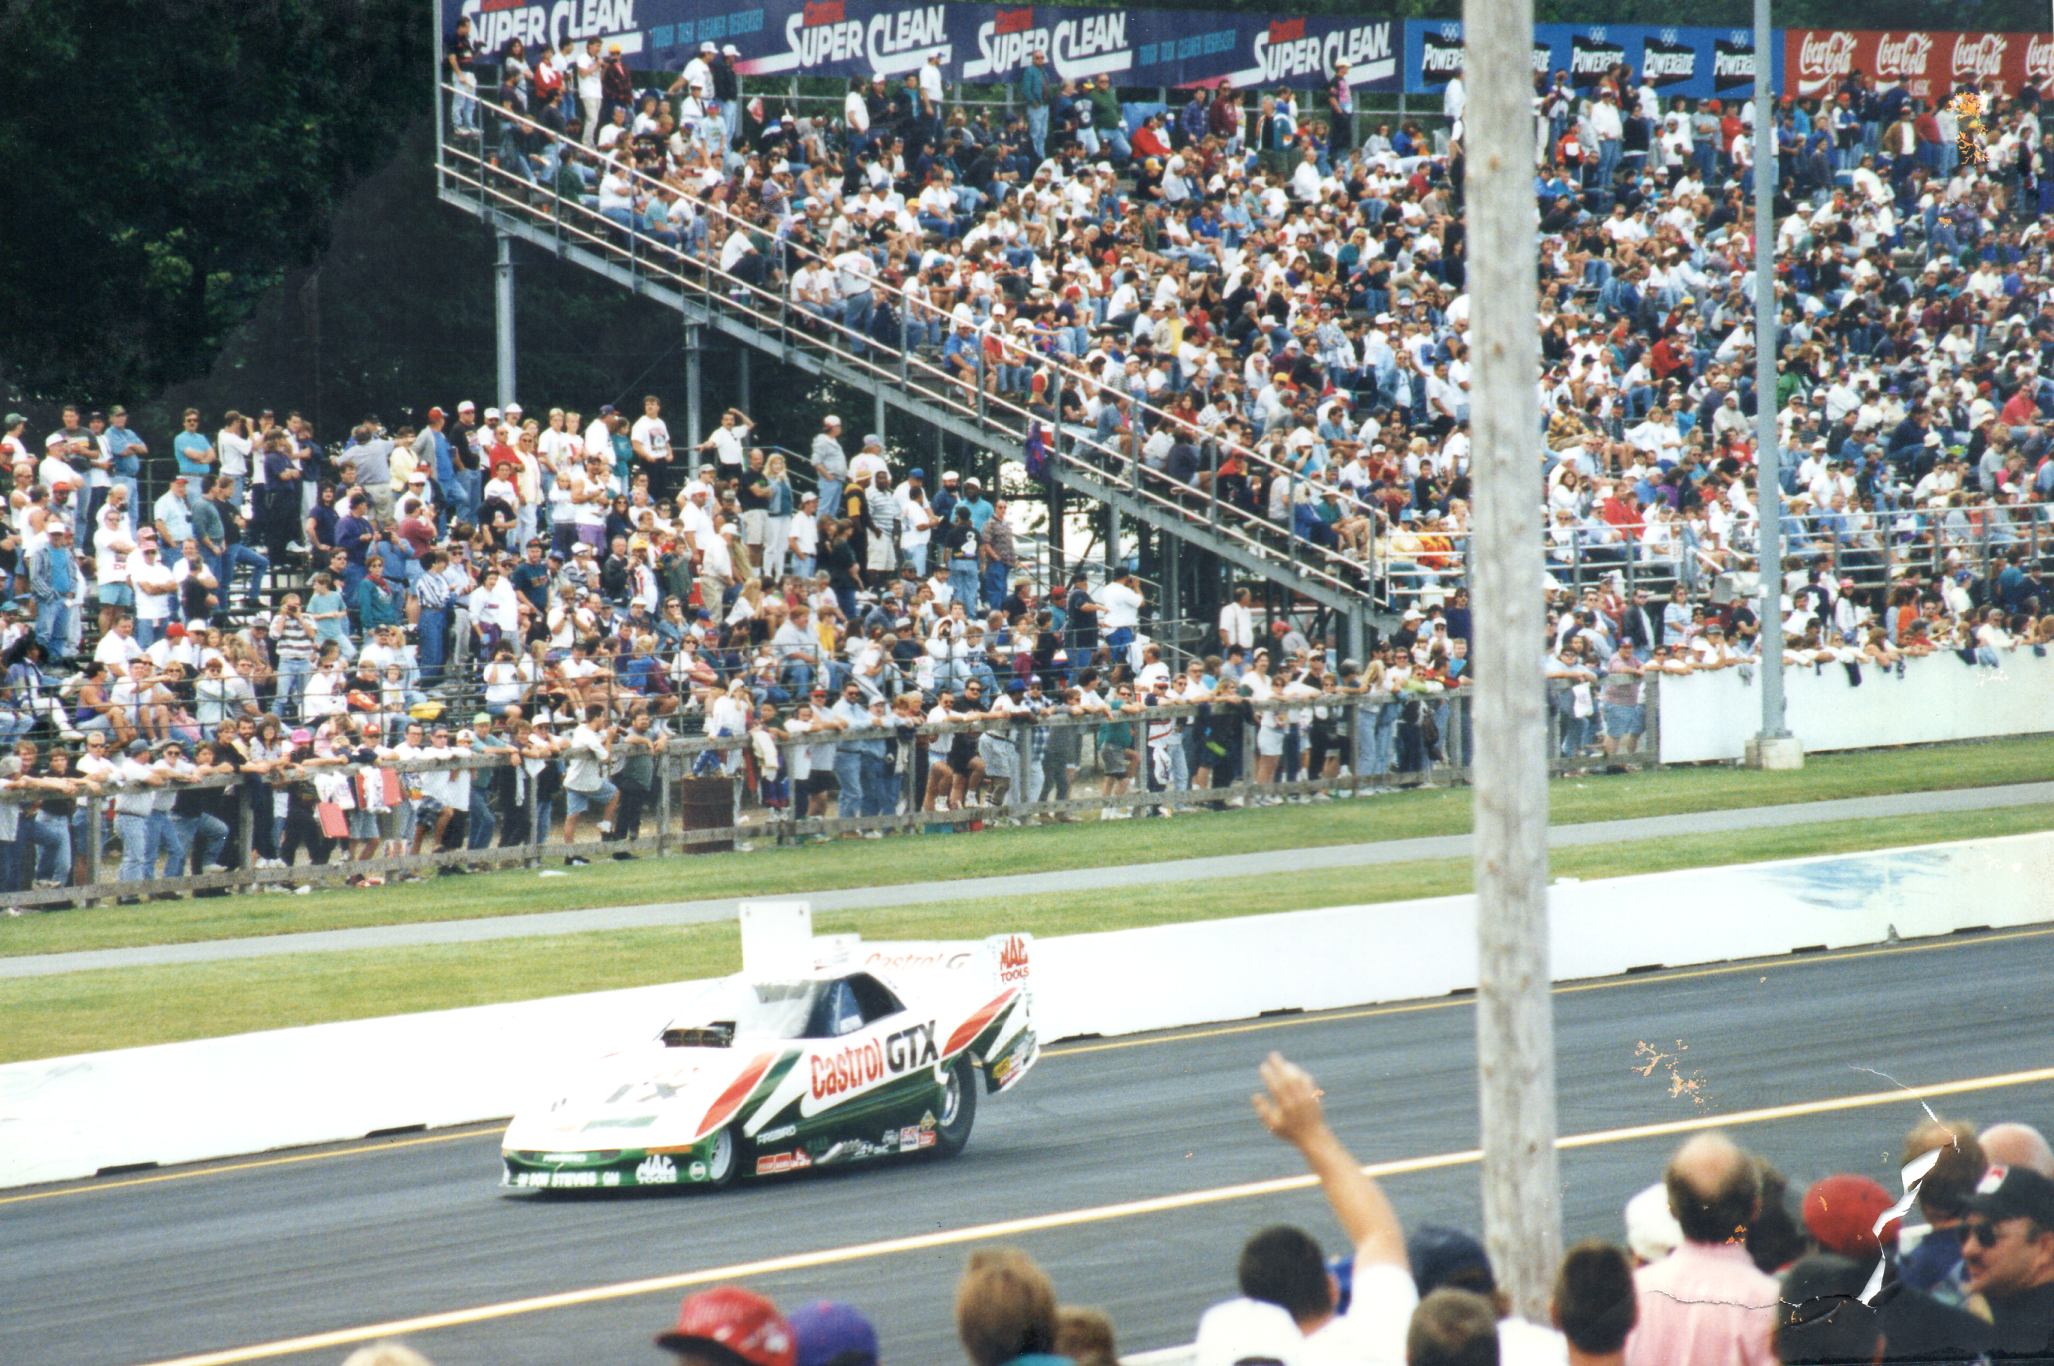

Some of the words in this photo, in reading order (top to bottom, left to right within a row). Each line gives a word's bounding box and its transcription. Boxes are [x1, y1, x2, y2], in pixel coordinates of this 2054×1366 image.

[462, 0, 546, 54] SUPER
[785, 12, 864, 67] SUPER
[976, 20, 1050, 75] SUPER
[1253, 30, 1321, 82] SUPER
[1000, 935, 1028, 969] MAC
[1000, 967, 1029, 983] TOOLS
[810, 1037, 884, 1100] Castrol
[886, 1019, 939, 1074] GTX
